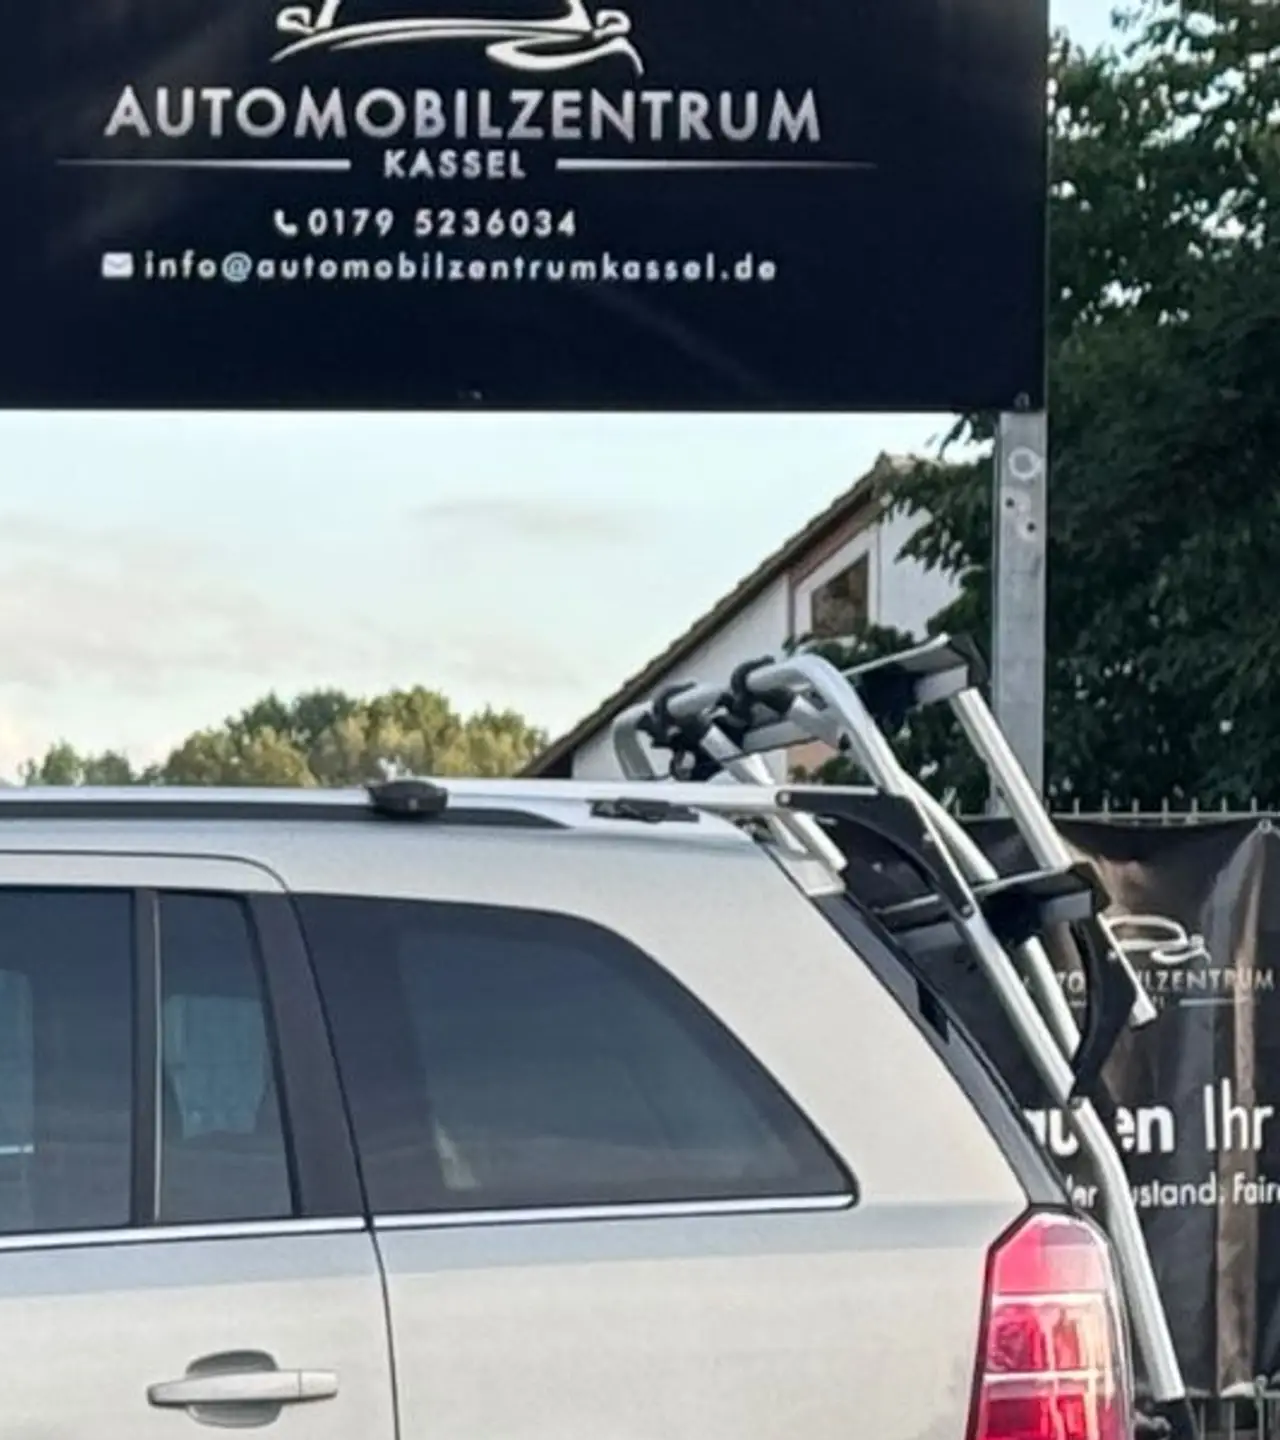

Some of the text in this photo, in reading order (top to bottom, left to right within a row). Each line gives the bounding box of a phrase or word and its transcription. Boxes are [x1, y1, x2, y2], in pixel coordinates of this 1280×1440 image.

[102, 84, 821, 143] AUTOMOBILZENTRUM
[383, 148, 527, 179] KASSEL
[306, 208, 577, 237] 0179 5236034
[144, 250, 778, 283] info@automobilzentrumkassel.de
[1203, 1077, 1275, 1152] Ihr
[1232, 1171, 1280, 1206] Fair
